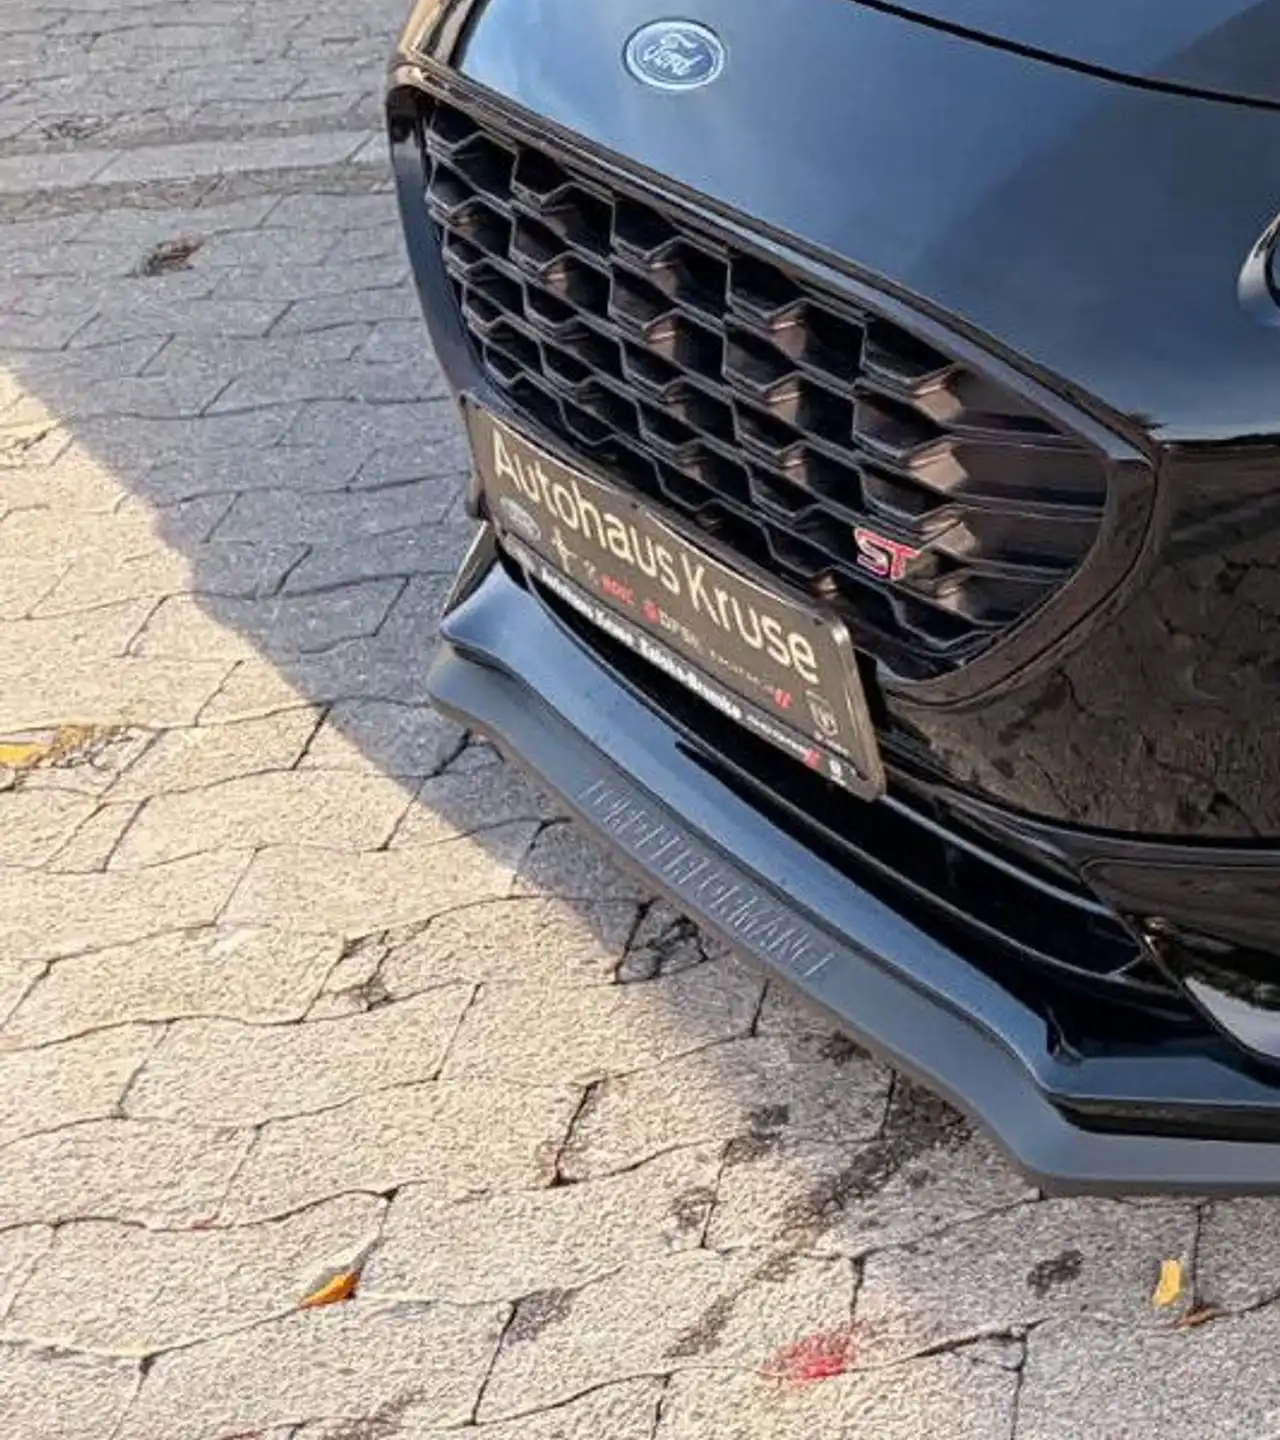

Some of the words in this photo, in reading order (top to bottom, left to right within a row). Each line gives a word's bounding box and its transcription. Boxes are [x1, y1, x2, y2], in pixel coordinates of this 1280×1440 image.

[492, 428, 681, 596] Autohaus
[680, 551, 820, 686] Kruse
[853, 526, 923, 581] ST
